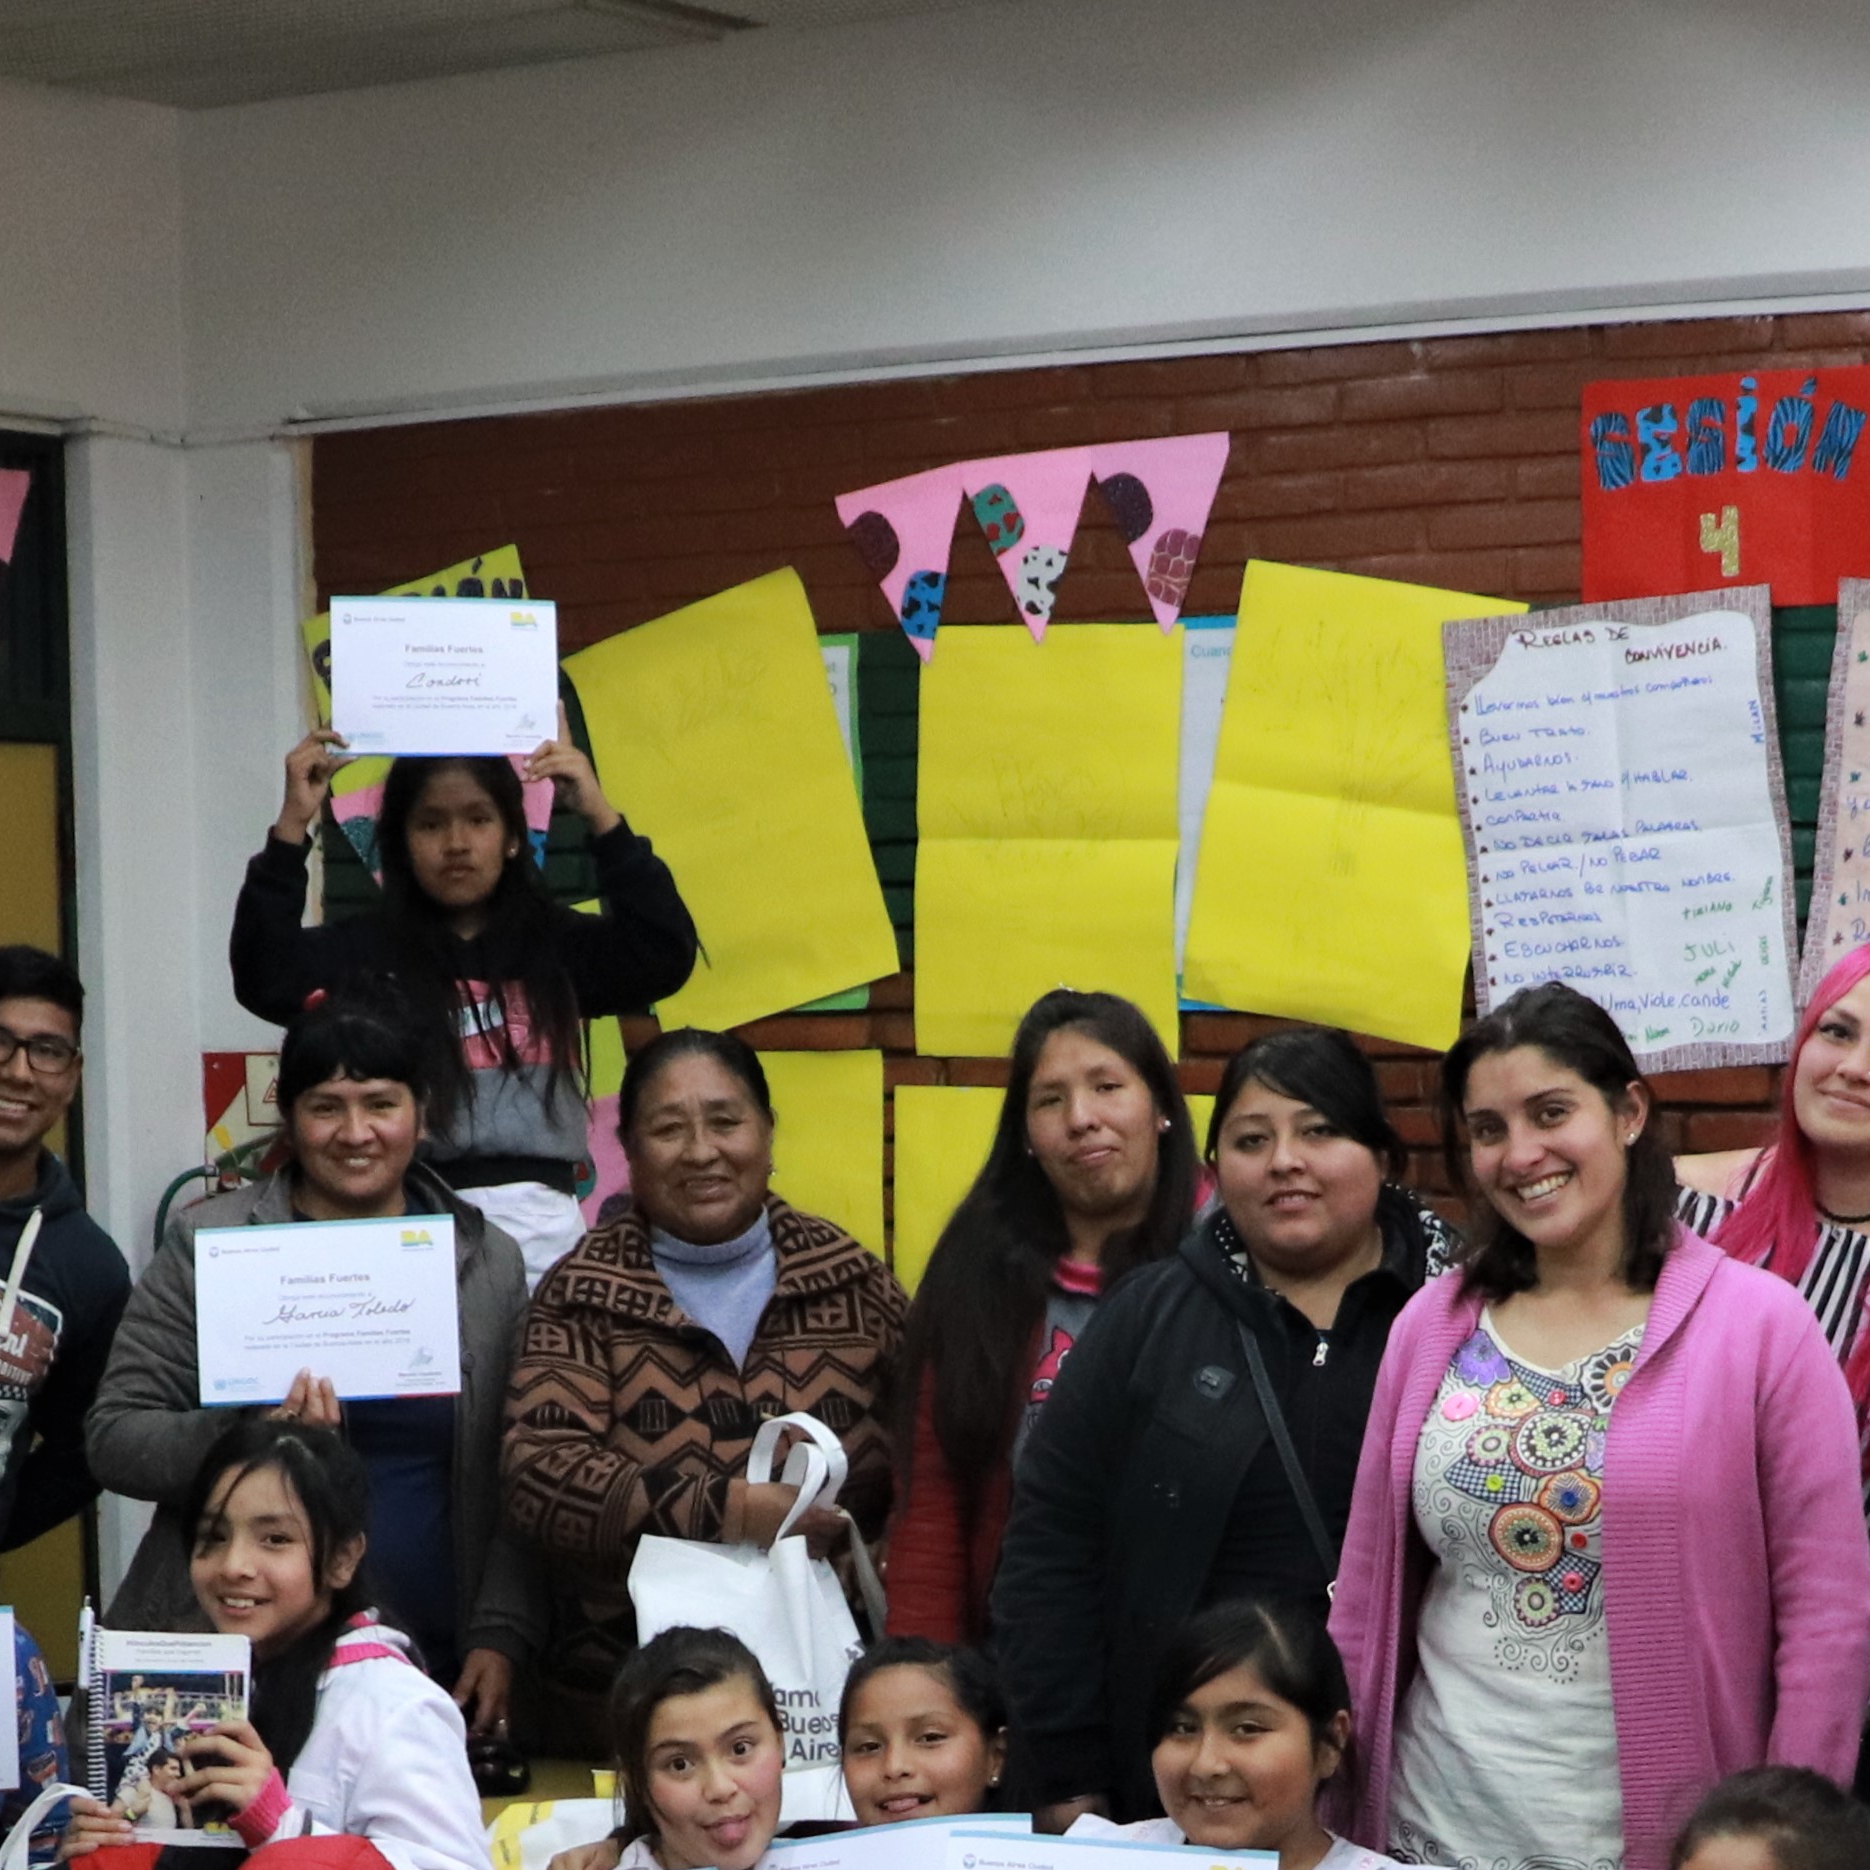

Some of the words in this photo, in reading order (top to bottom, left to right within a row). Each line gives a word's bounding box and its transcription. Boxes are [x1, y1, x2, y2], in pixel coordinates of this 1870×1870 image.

[1590, 376, 1867, 491] SESIÓN
[1700, 505, 1740, 577] 4
[1605, 626, 1630, 641] DE
[404, 644, 445, 654] Familias
[447, 645, 484, 654] Fuertes
[280, 1274, 326, 1286] Familias
[329, 1272, 371, 1283] Fuertes
